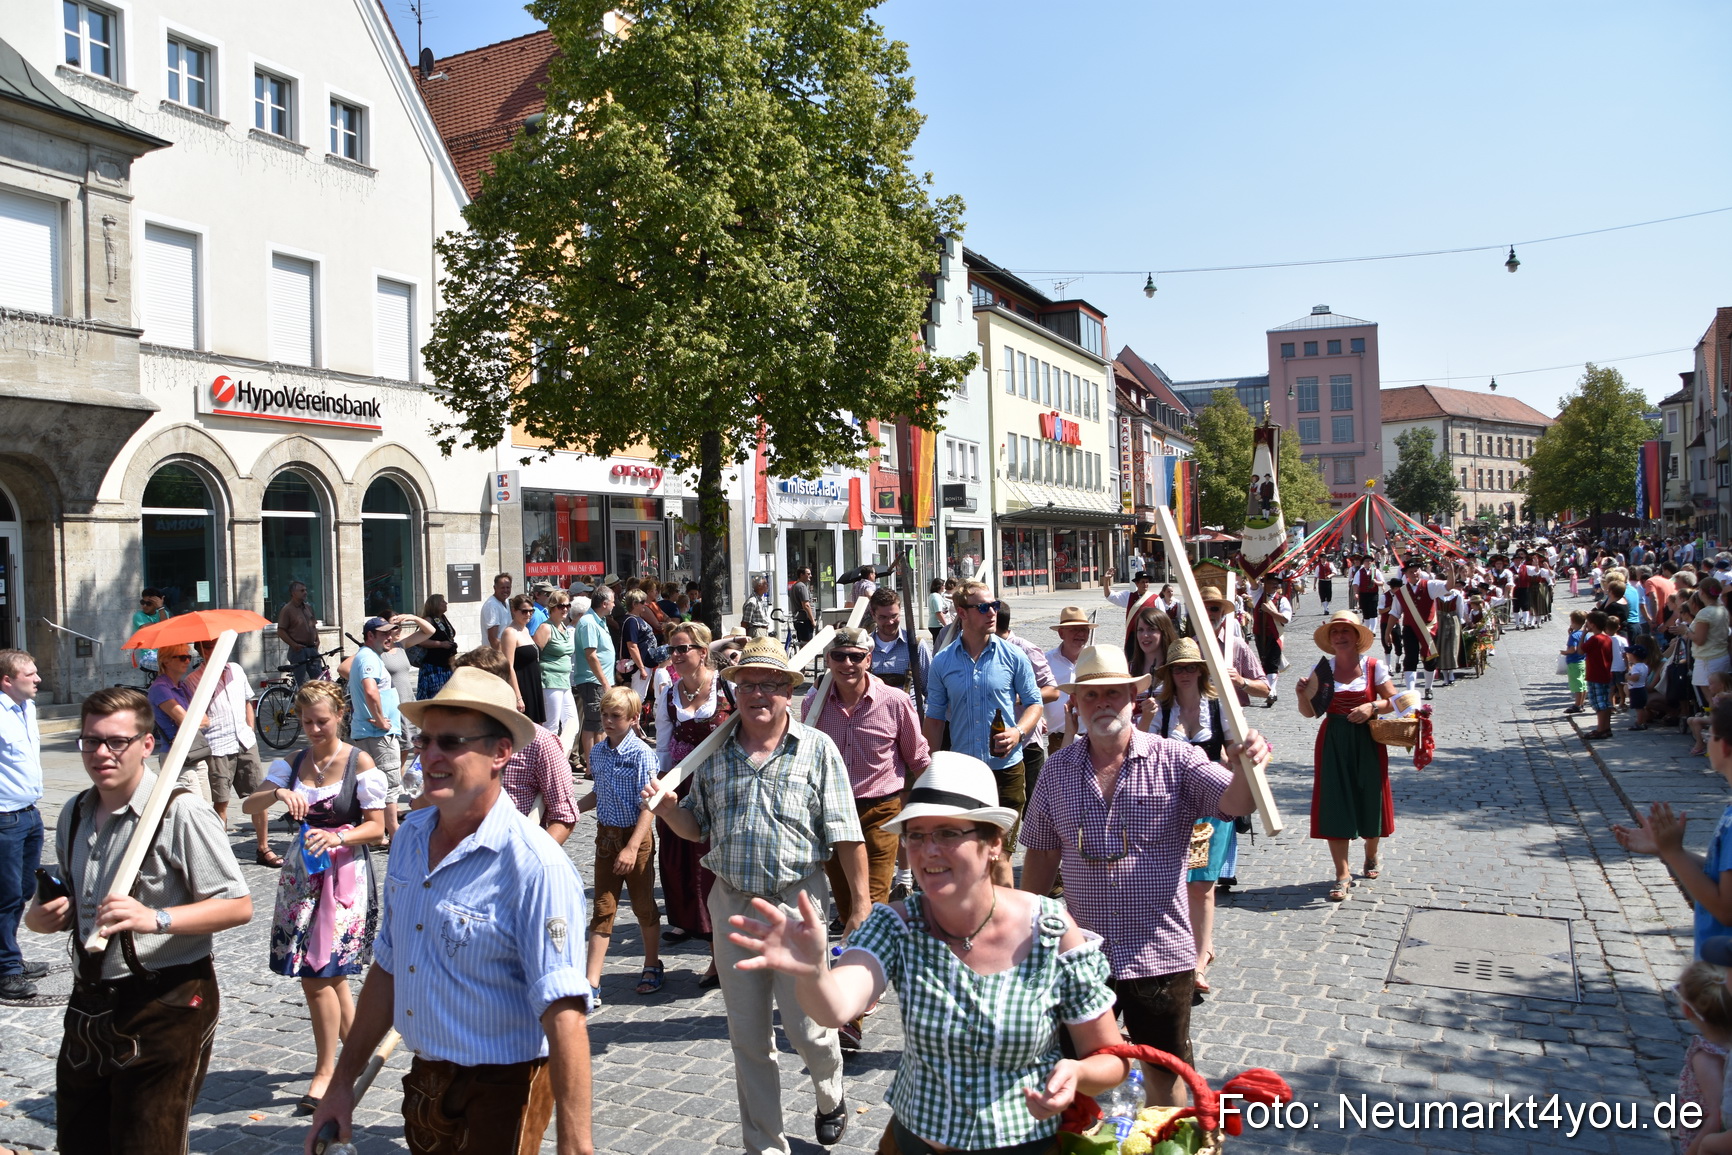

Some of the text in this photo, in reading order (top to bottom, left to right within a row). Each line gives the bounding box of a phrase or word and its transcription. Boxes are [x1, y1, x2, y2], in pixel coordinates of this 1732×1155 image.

[238, 380, 381, 418] HypoVereinsbank
[611, 464, 663, 490] orsay
[822, 480, 841, 500] lady
